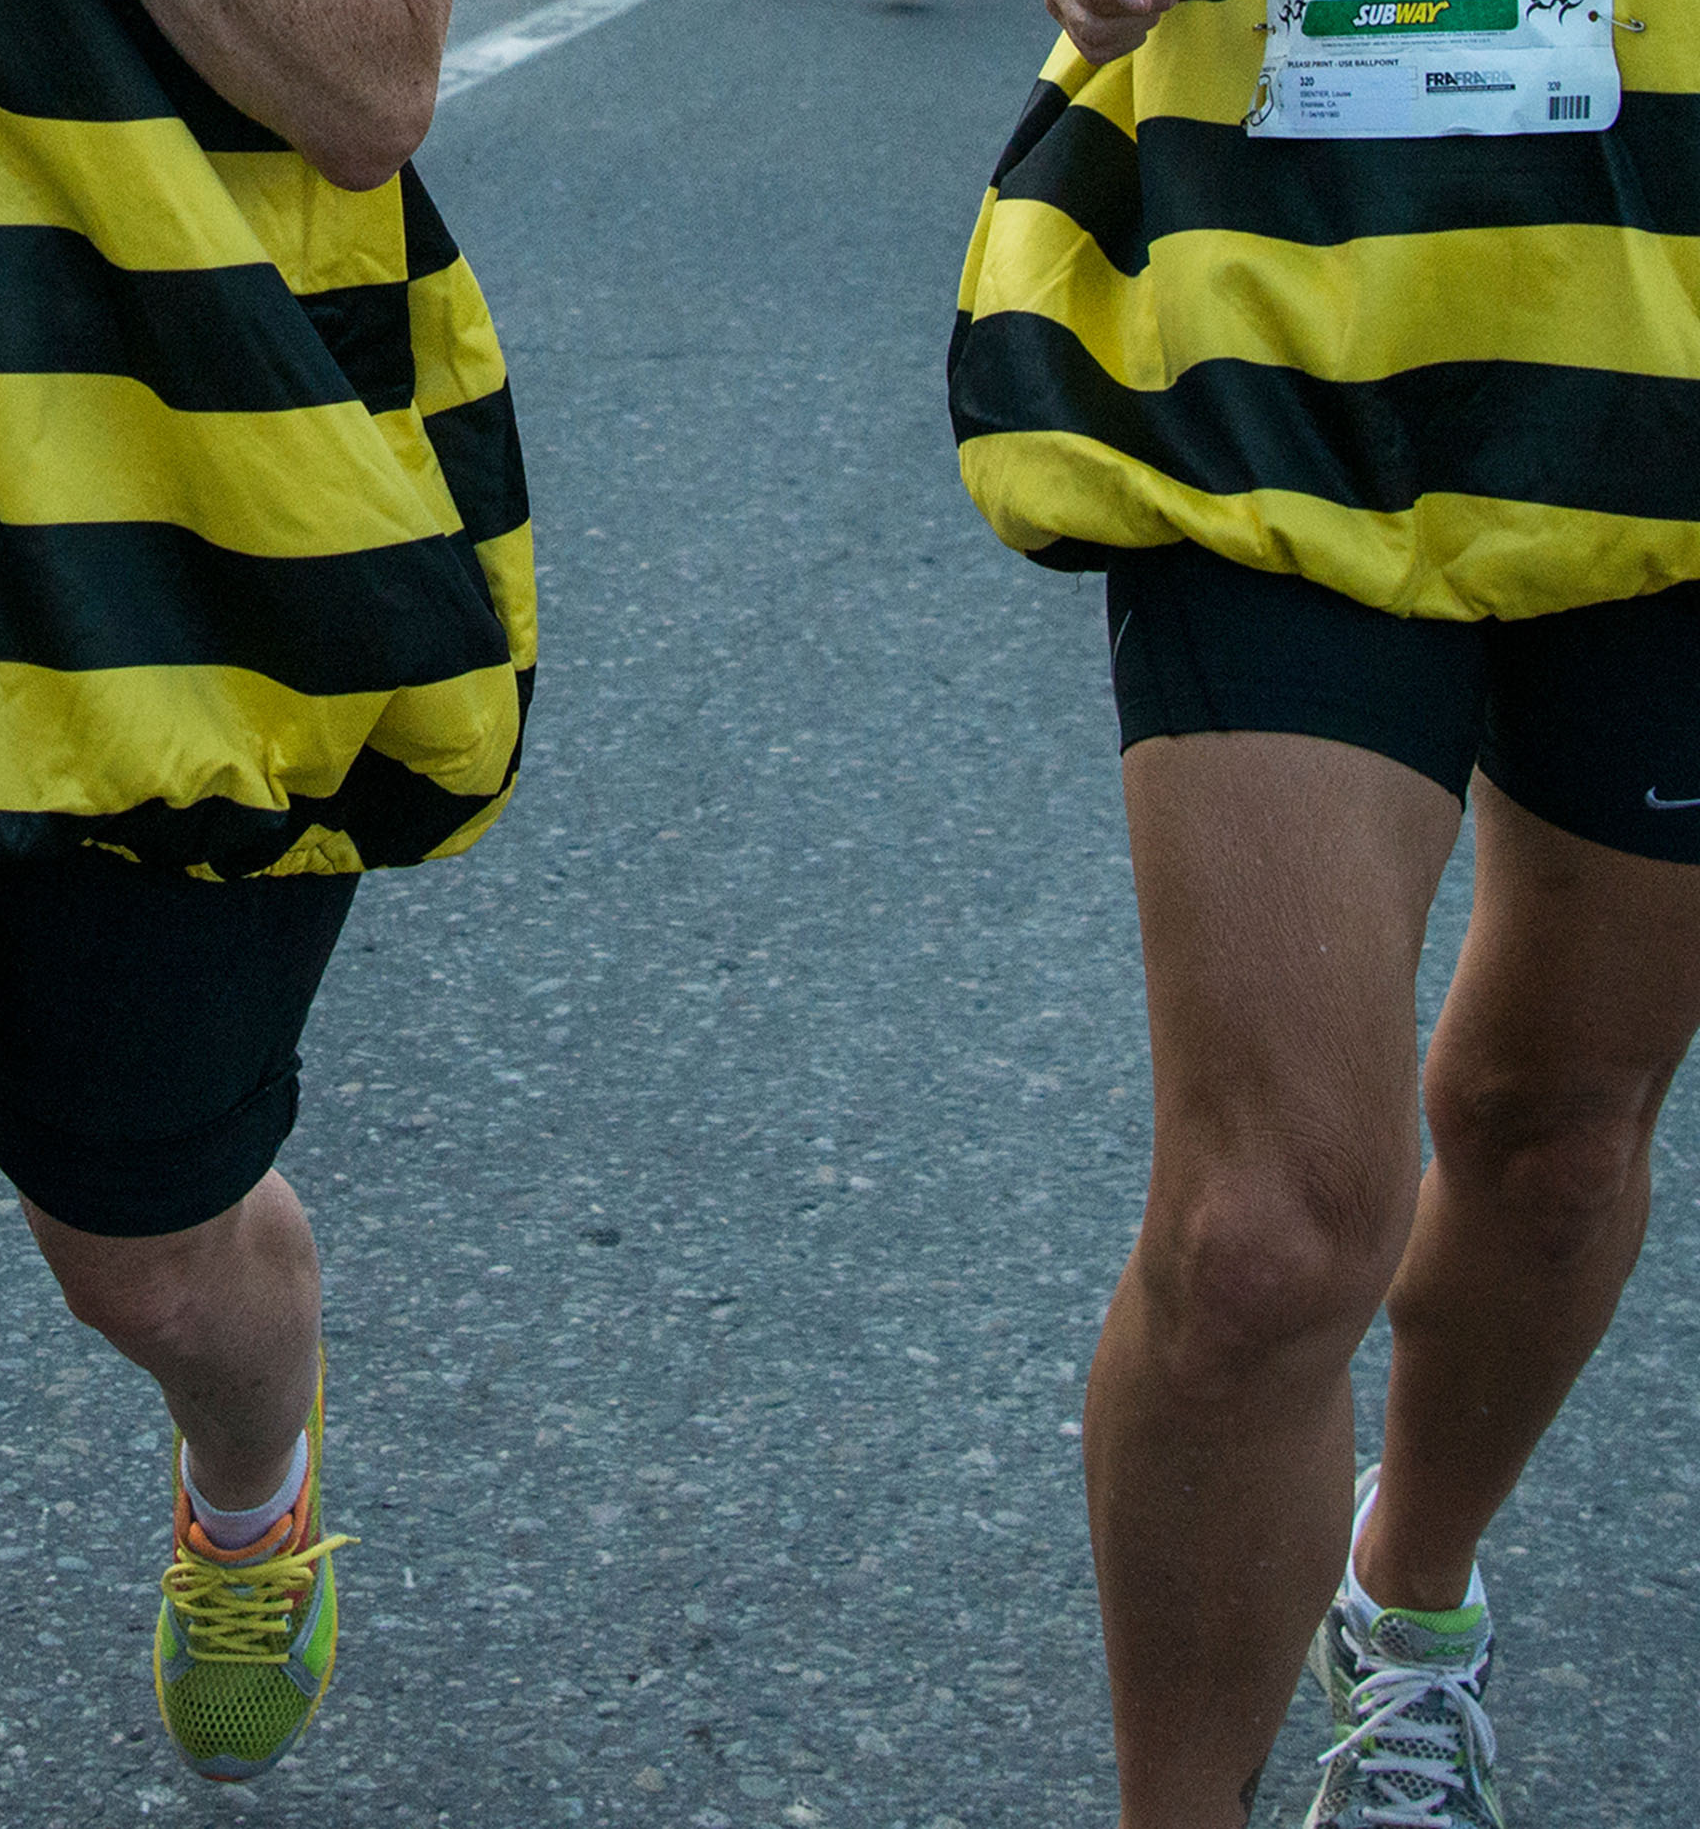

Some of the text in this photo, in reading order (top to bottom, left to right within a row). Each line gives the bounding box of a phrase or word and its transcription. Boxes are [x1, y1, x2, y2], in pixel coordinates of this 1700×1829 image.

[1287, 60, 1311, 68] PLEASE
[1312, 60, 1333, 68] PRINT
[1355, 59, 1399, 67] BALLPOINT
[1300, 76, 1315, 87] 320
[1547, 81, 1561, 91] 320
